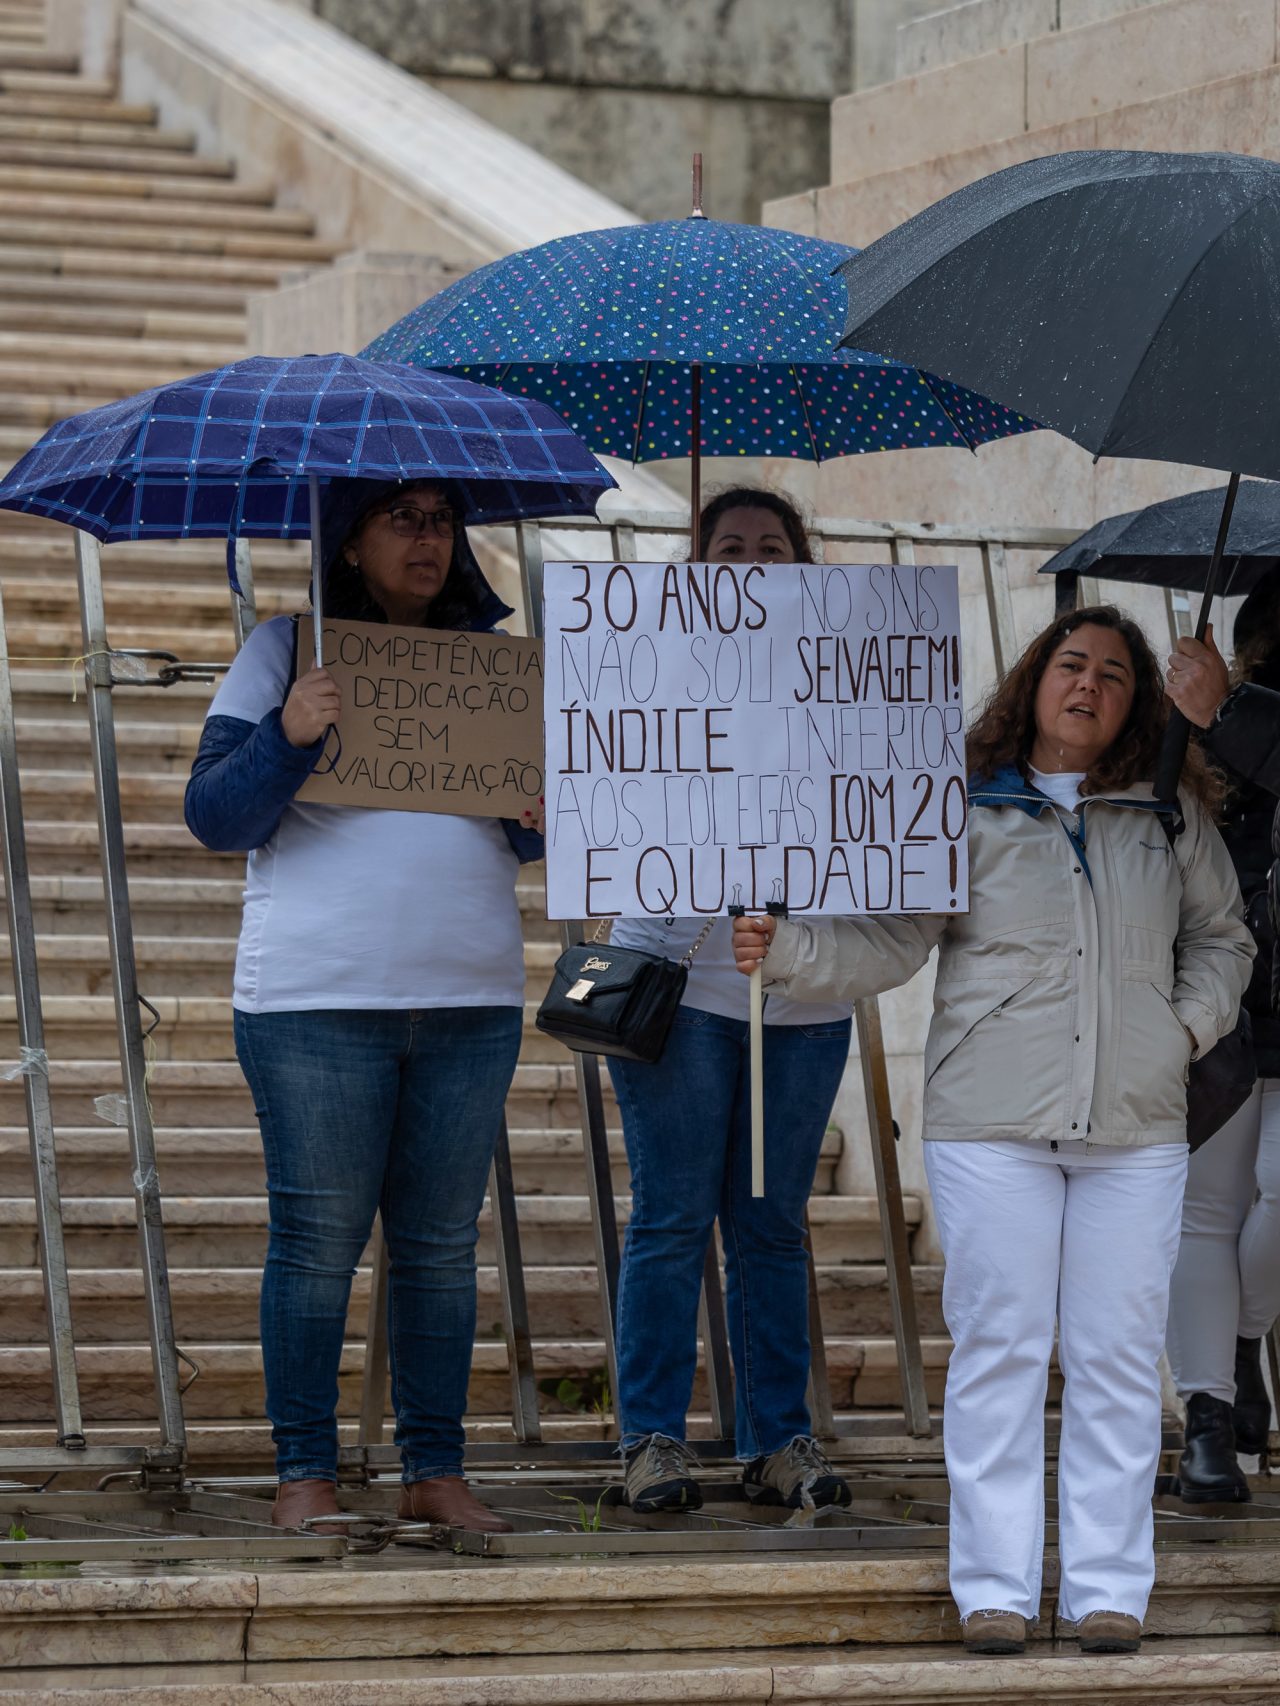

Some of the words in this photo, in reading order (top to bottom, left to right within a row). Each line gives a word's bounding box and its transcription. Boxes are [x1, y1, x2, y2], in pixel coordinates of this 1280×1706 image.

[560, 564, 637, 633] 30
[659, 564, 767, 634] ANOS
[800, 568, 851, 633] NO
[867, 566, 939, 632] SNS
[321, 629, 543, 678] COMPETÊNCIA
[562, 629, 658, 702] NÃO
[687, 635, 771, 703] SOU
[795, 635, 960, 702] SELVAGEM!
[355, 676, 529, 714] DEDICAÇÃO
[374, 716, 449, 753] SEM
[559, 701, 733, 774] ÍNDICE
[779, 706, 962, 771] INFERIOR
[324, 753, 542, 796] VALORIZAÇÃO
[554, 777, 643, 847] AOS
[664, 774, 816, 847] COLEGAS
[831, 774, 895, 842] COM
[904, 775, 967, 841] 20
